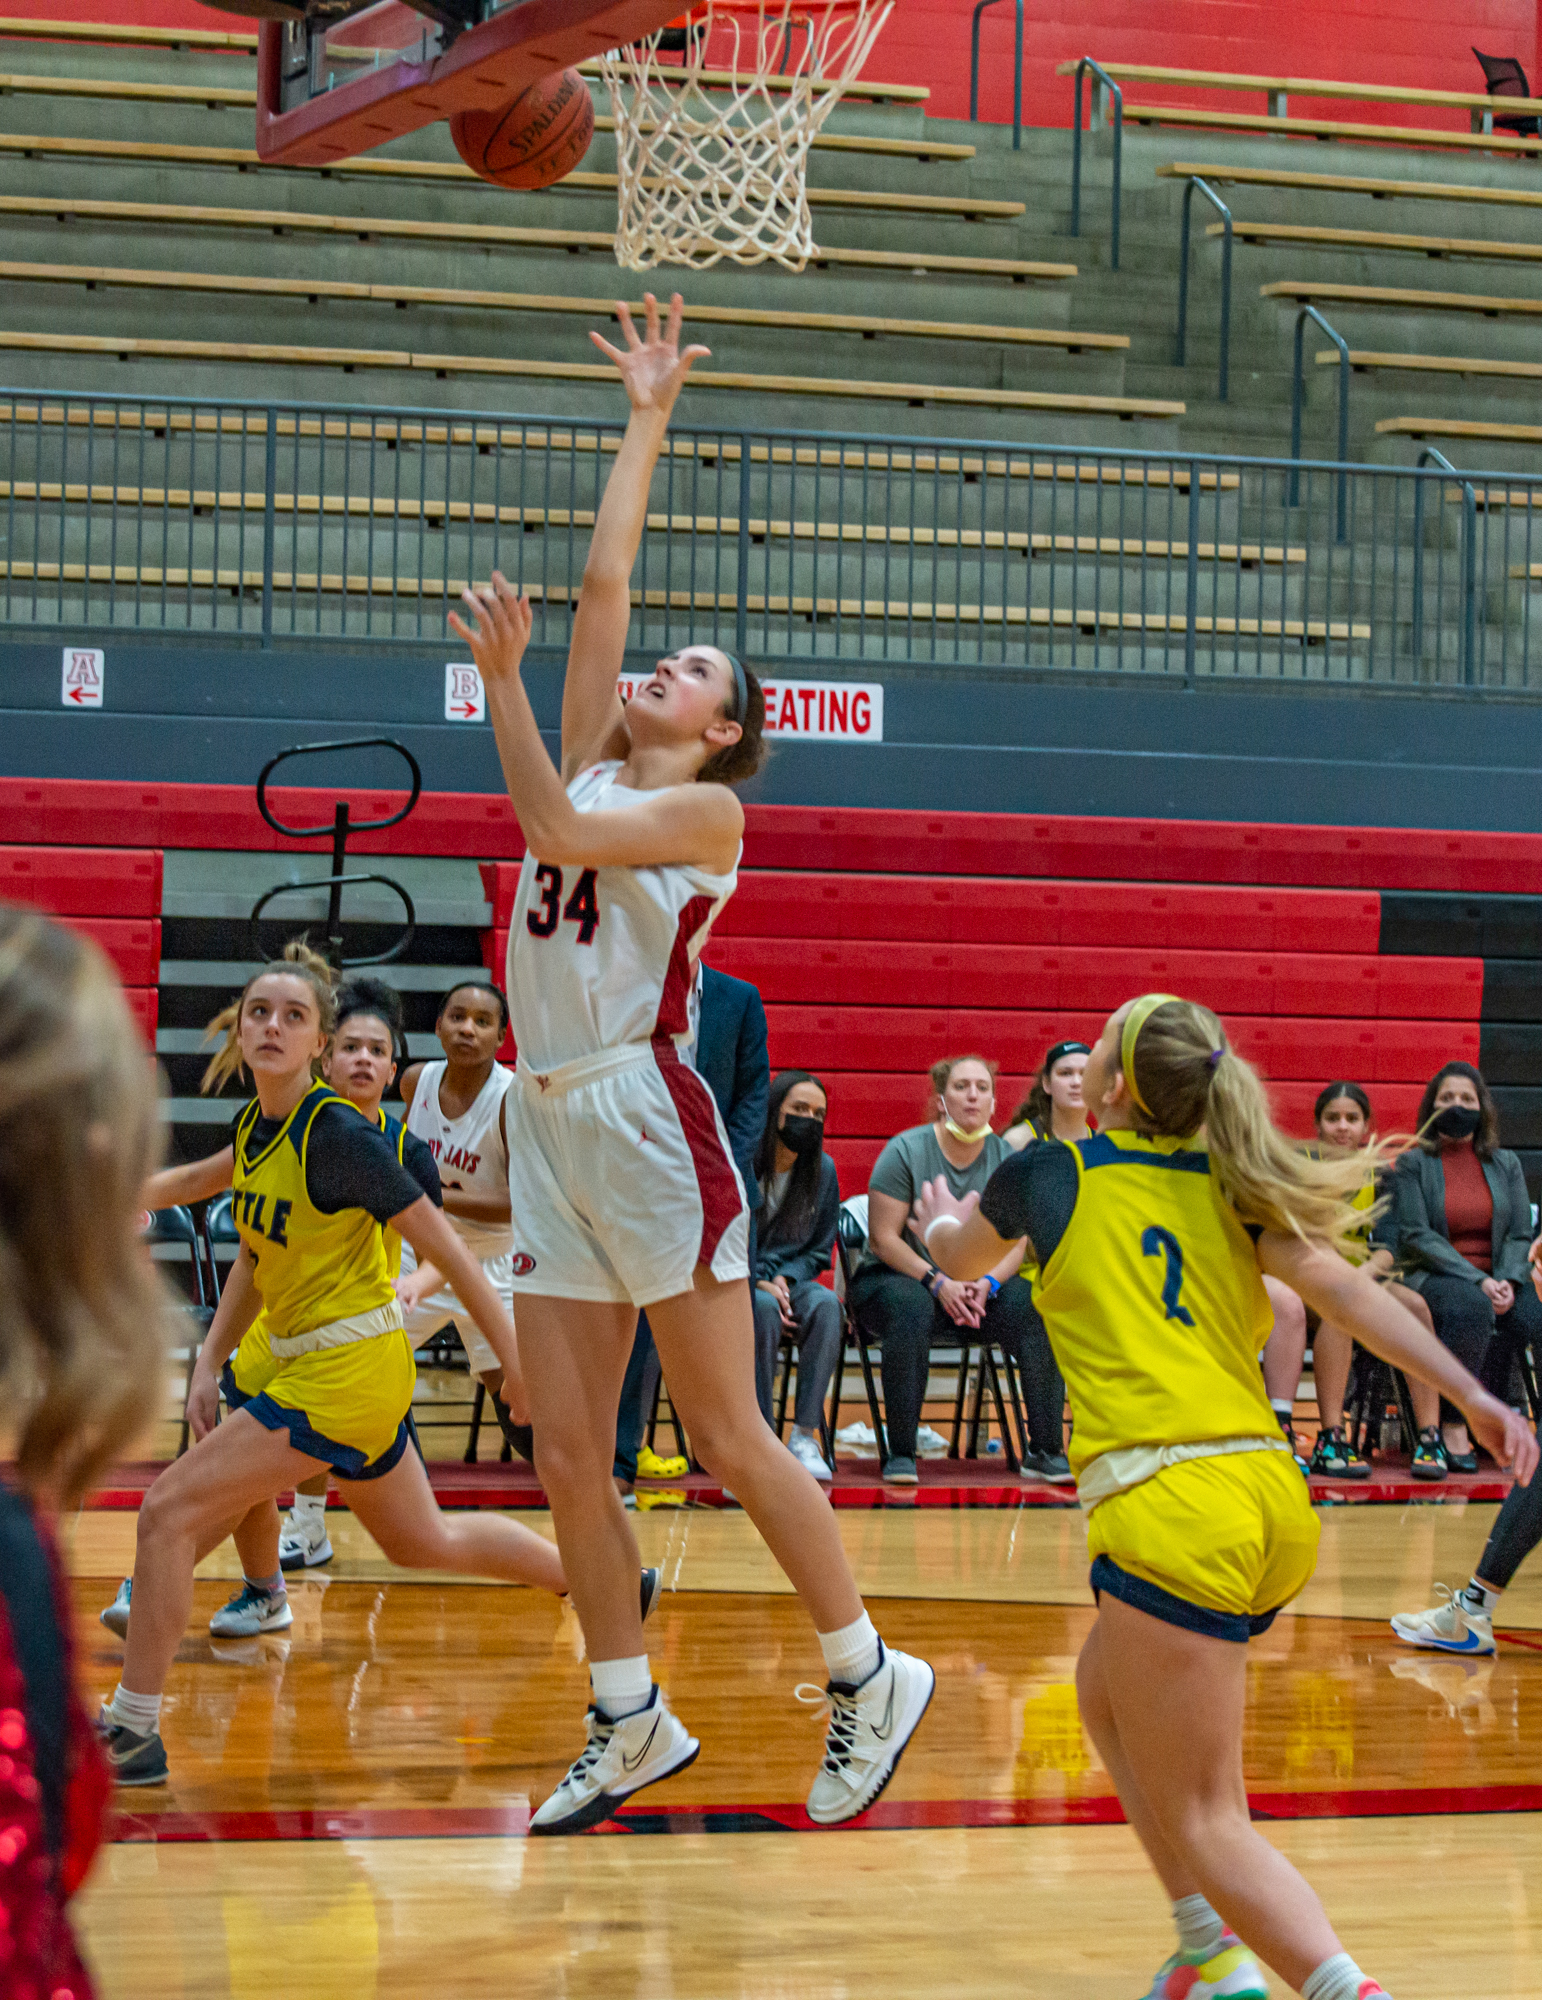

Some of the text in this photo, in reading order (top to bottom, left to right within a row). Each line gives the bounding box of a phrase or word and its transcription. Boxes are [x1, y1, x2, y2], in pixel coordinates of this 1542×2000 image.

[508, 70, 580, 155] SPALDING
[67, 651, 100, 685] A
[452, 667, 479, 700] B
[527, 864, 600, 947] 34
[444, 1144, 482, 1175] JAYS
[1141, 1225, 1196, 1327] 2
